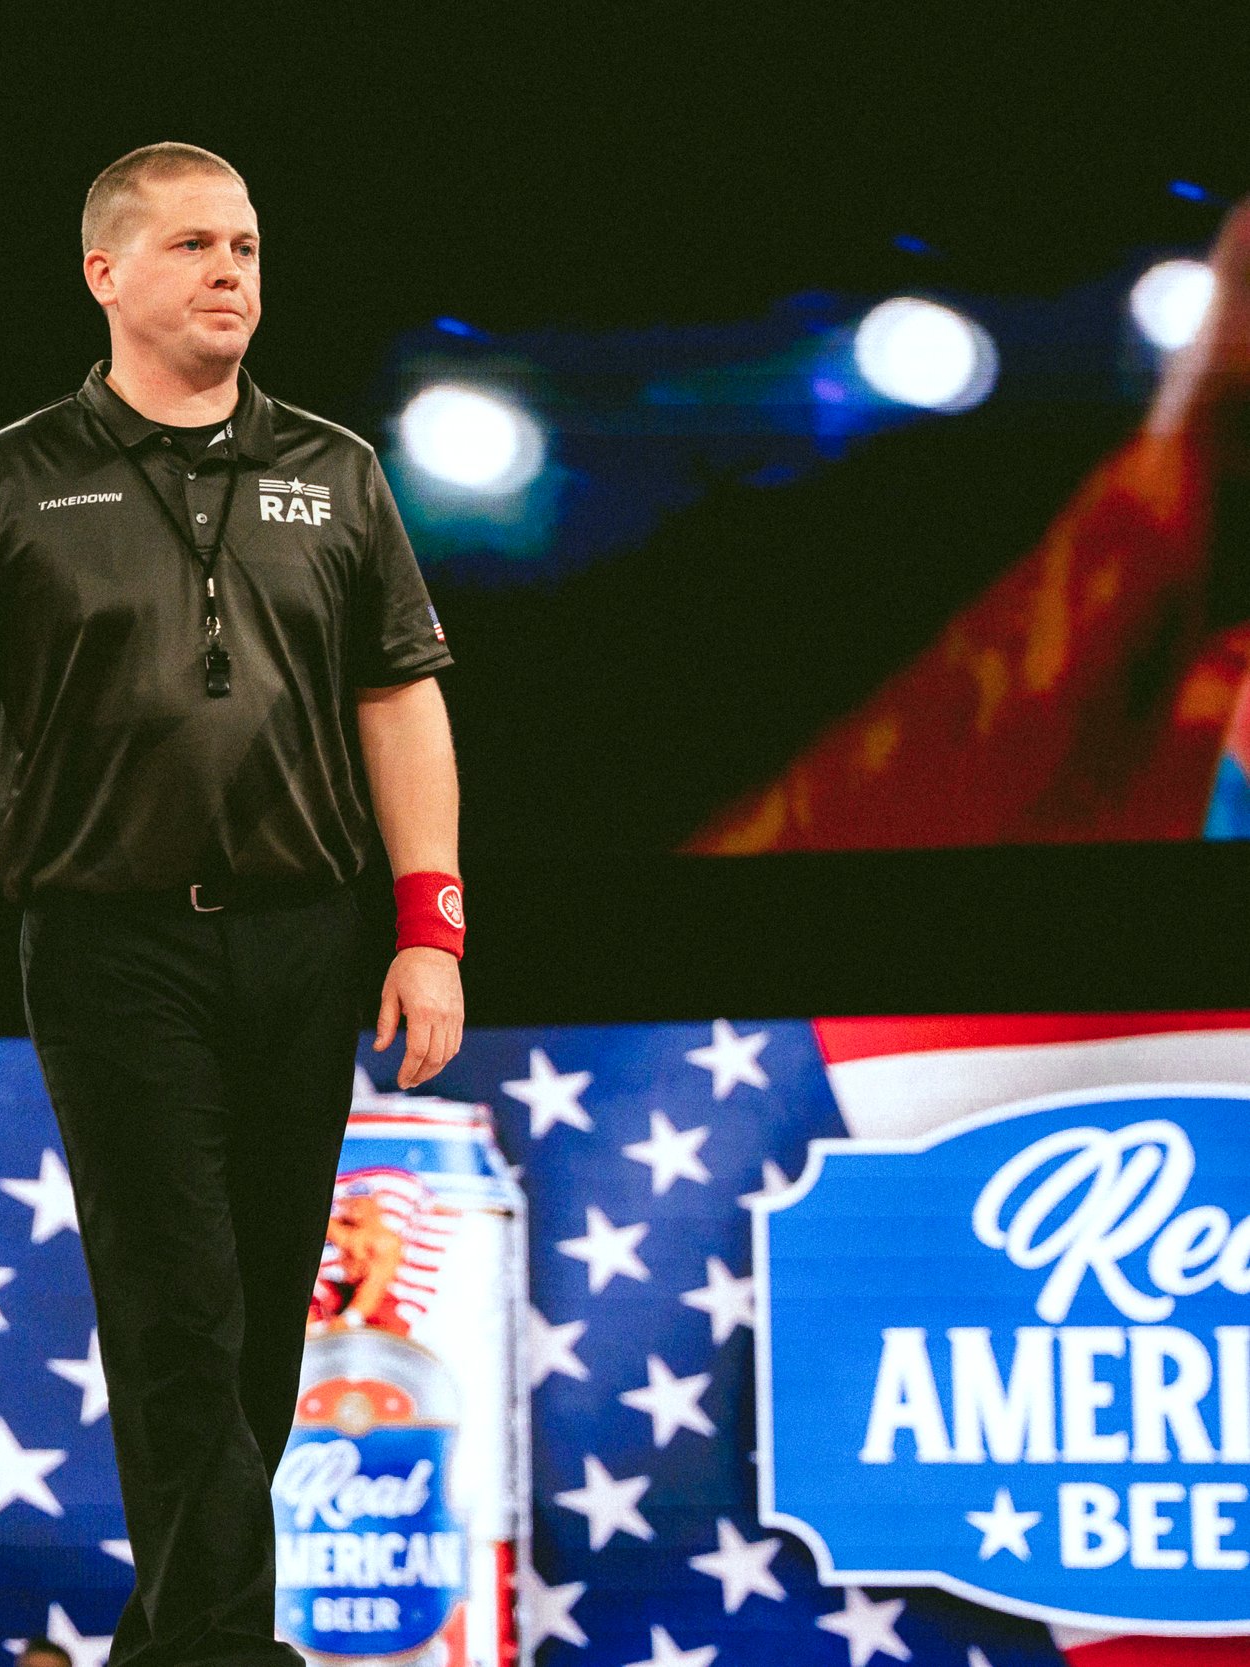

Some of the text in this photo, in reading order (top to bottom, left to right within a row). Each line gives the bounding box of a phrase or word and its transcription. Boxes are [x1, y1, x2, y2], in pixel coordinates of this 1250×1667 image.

[38, 492, 123, 511] TAKEDOWN
[259, 494, 332, 527] RAF
[271, 1439, 434, 1529] Real
[1057, 1481, 1249, 1571] BEE
[275, 1531, 462, 1588] MERICAN
[312, 1596, 401, 1633] BEER
